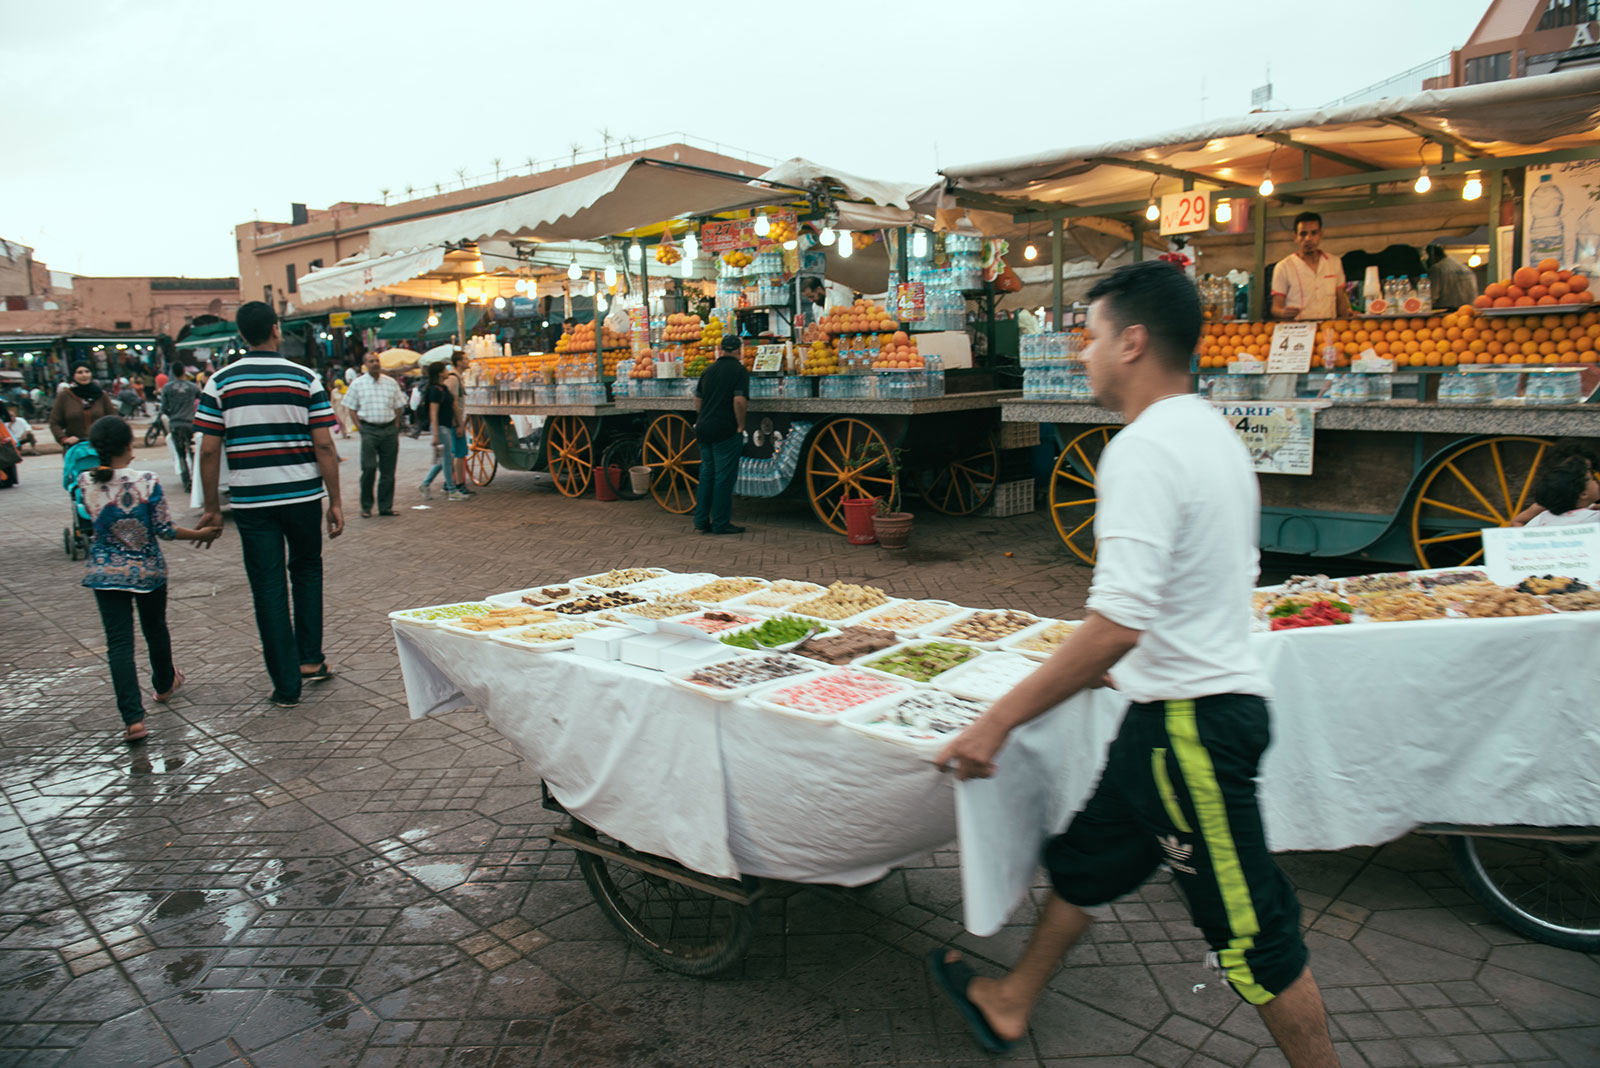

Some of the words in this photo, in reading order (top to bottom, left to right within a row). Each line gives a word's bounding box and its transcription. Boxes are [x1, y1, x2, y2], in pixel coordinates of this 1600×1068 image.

[1570, 22, 1600, 49] A
[1178, 195, 1206, 227] 29
[714, 223, 731, 236] 27
[1279, 335, 1289, 351] 4
[1221, 406, 1275, 416] TARIF
[1235, 417, 1250, 433] 4
[1250, 424, 1268, 434] dh
